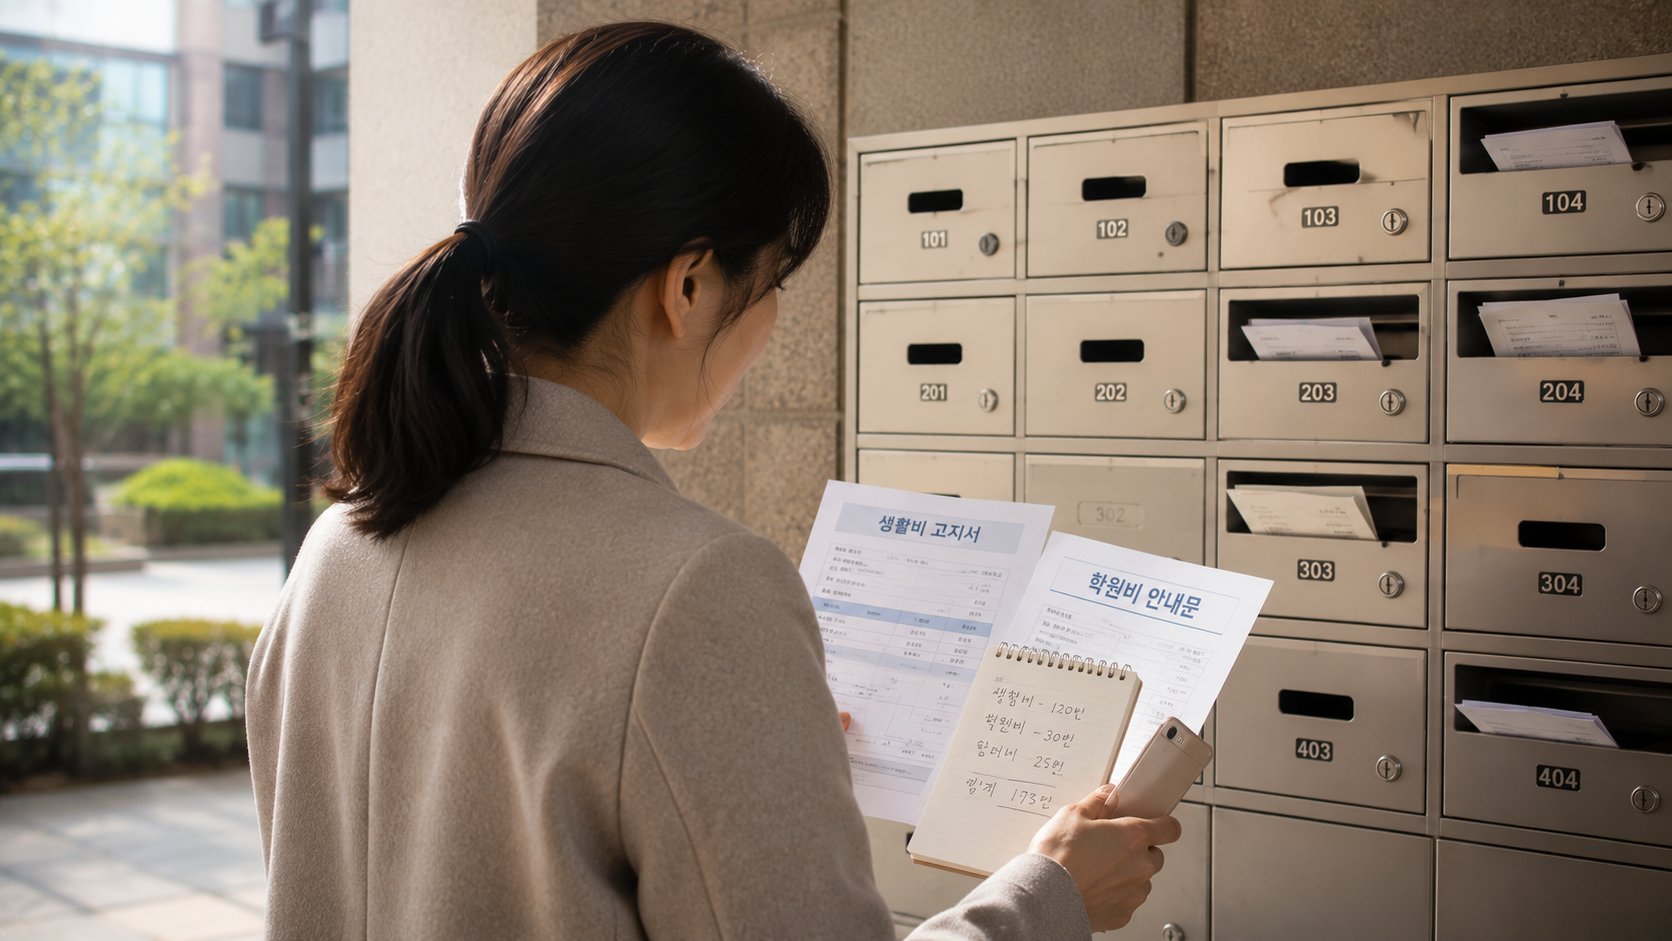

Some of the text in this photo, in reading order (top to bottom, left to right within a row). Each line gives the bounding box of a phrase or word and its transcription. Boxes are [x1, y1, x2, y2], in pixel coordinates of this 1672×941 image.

[1545, 193, 1584, 213] 104
[1304, 208, 1336, 226] 103
[1099, 221, 1127, 238] 102
[923, 232, 946, 247] 101
[922, 385, 945, 400] 201
[1096, 385, 1125, 401] 202
[1302, 384, 1335, 401] 203
[1542, 383, 1582, 401] 204
[1096, 506, 1125, 523] 302
[878, 514, 981, 544] 생활비 고지서
[1299, 561, 1333, 580] 303
[1540, 573, 1580, 596] 304
[1088, 571, 1202, 619] 학원비 안내문
[1297, 739, 1332, 759] 403
[1538, 766, 1579, 790] 404
